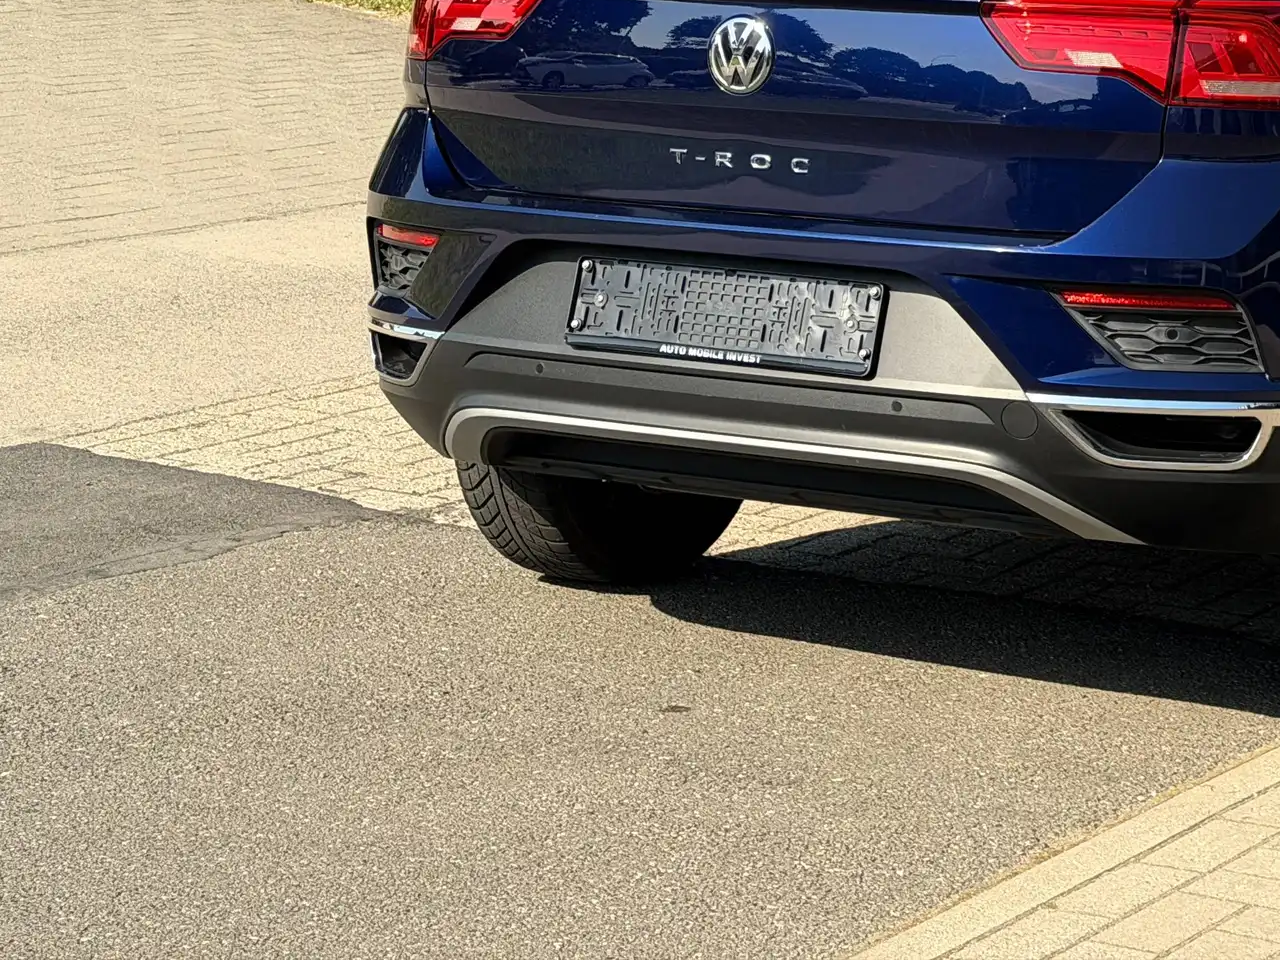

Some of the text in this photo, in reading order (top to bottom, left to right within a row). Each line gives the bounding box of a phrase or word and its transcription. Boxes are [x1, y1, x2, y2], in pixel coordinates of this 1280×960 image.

[669, 147, 811, 173] T-ROC
[659, 343, 762, 364] AUTO MOBILE INVEST
